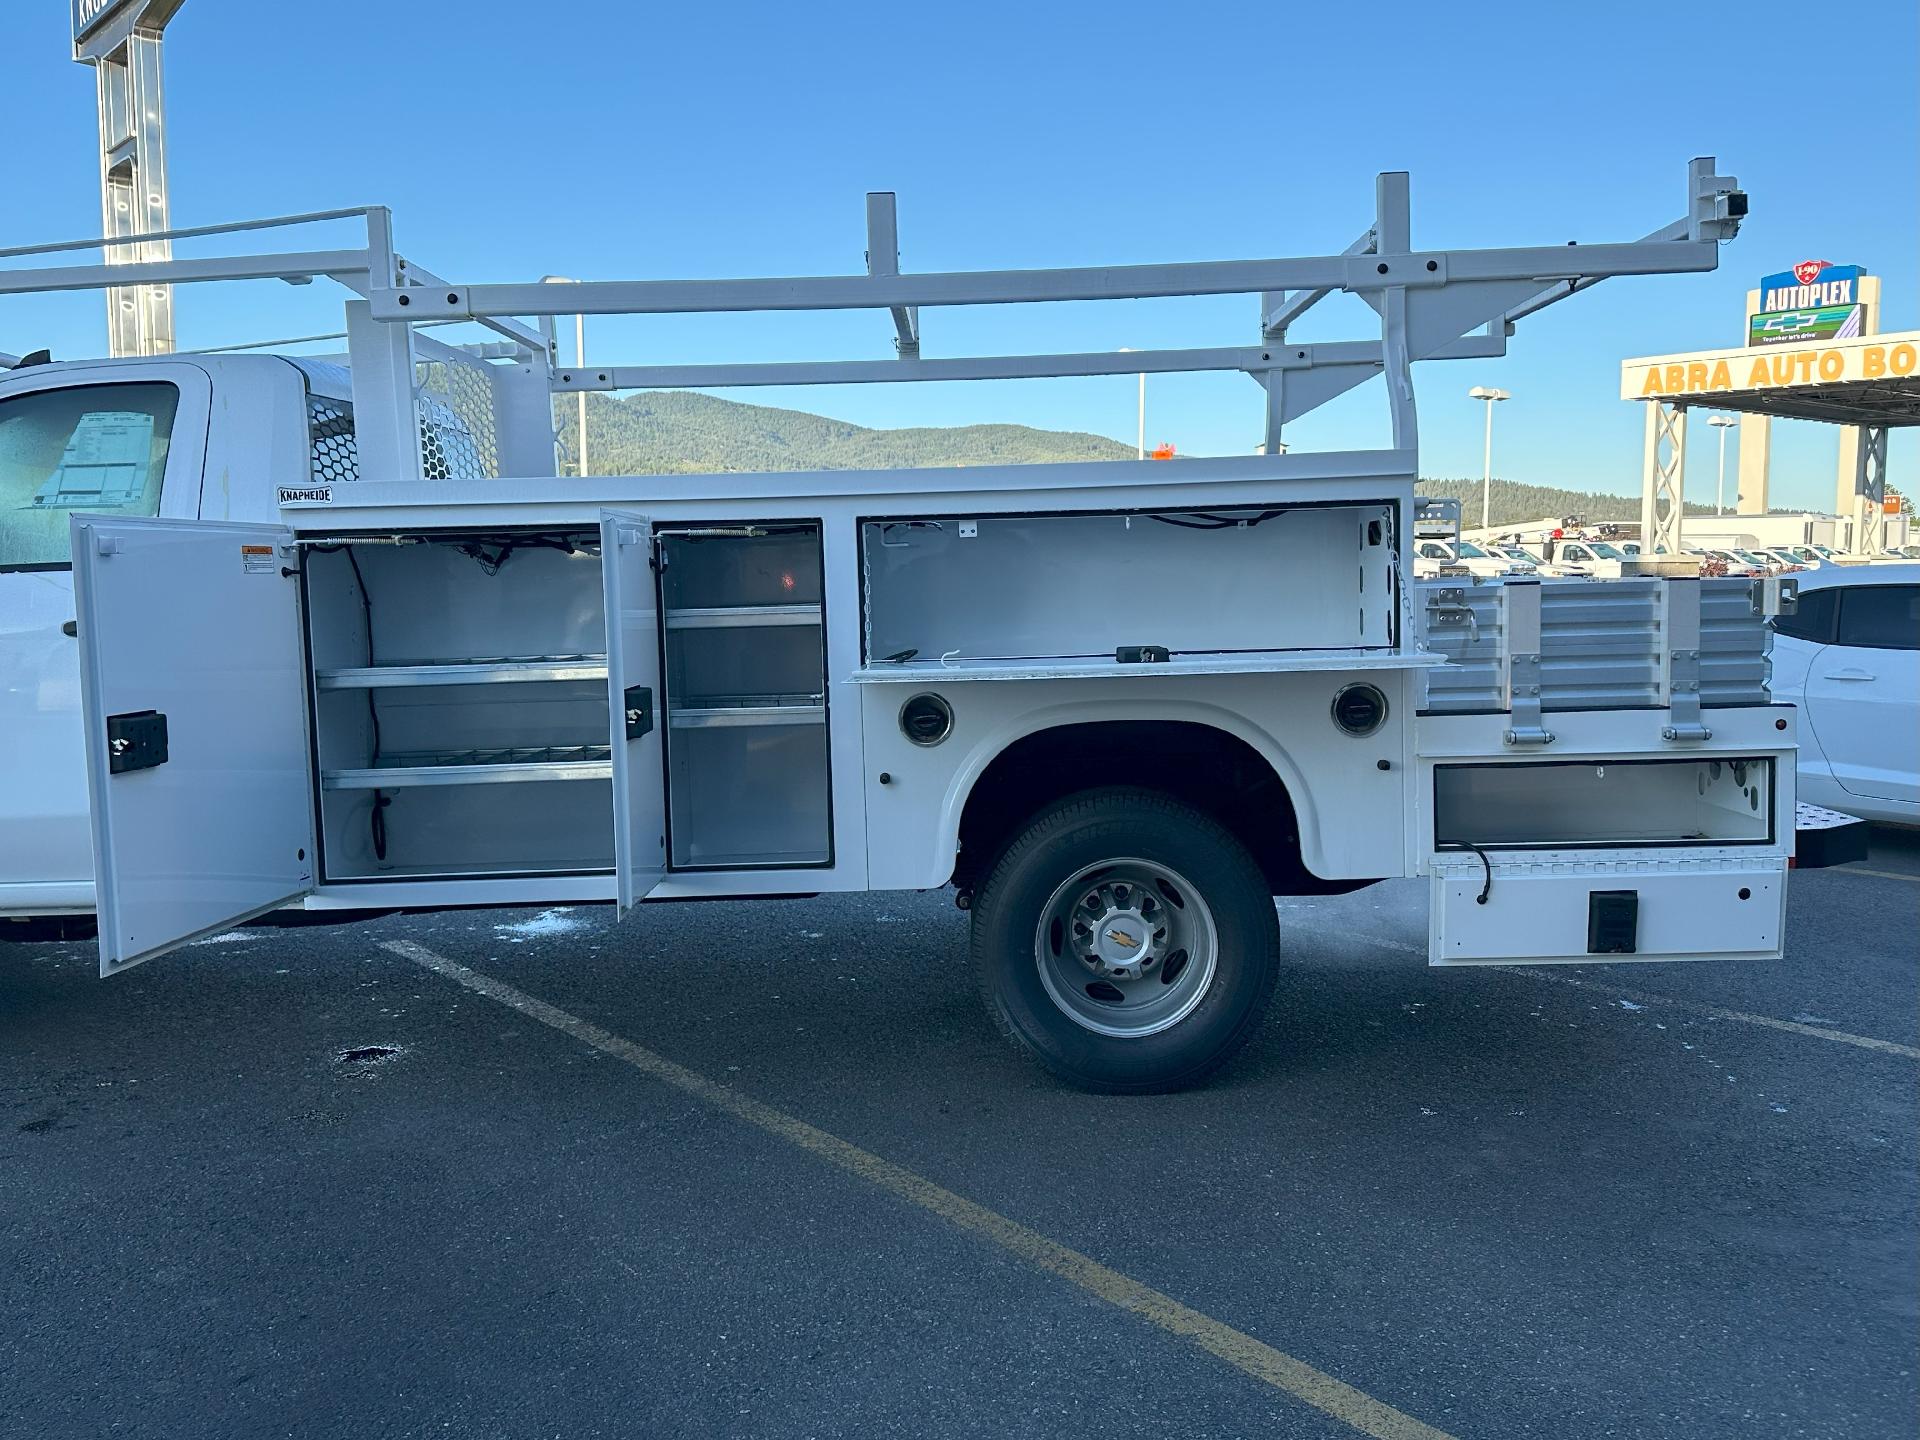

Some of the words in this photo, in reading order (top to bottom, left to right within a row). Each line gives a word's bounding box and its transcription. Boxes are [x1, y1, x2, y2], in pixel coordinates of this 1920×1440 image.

[1798, 265, 1818, 276] I-90
[1765, 280, 1851, 312] AUTOPLEX
[1642, 360, 1732, 395] ABRA
[1748, 350, 1845, 388] AUTO
[1862, 343, 1917, 379] BO
[280, 489, 331, 503] KNAPHEIDE
